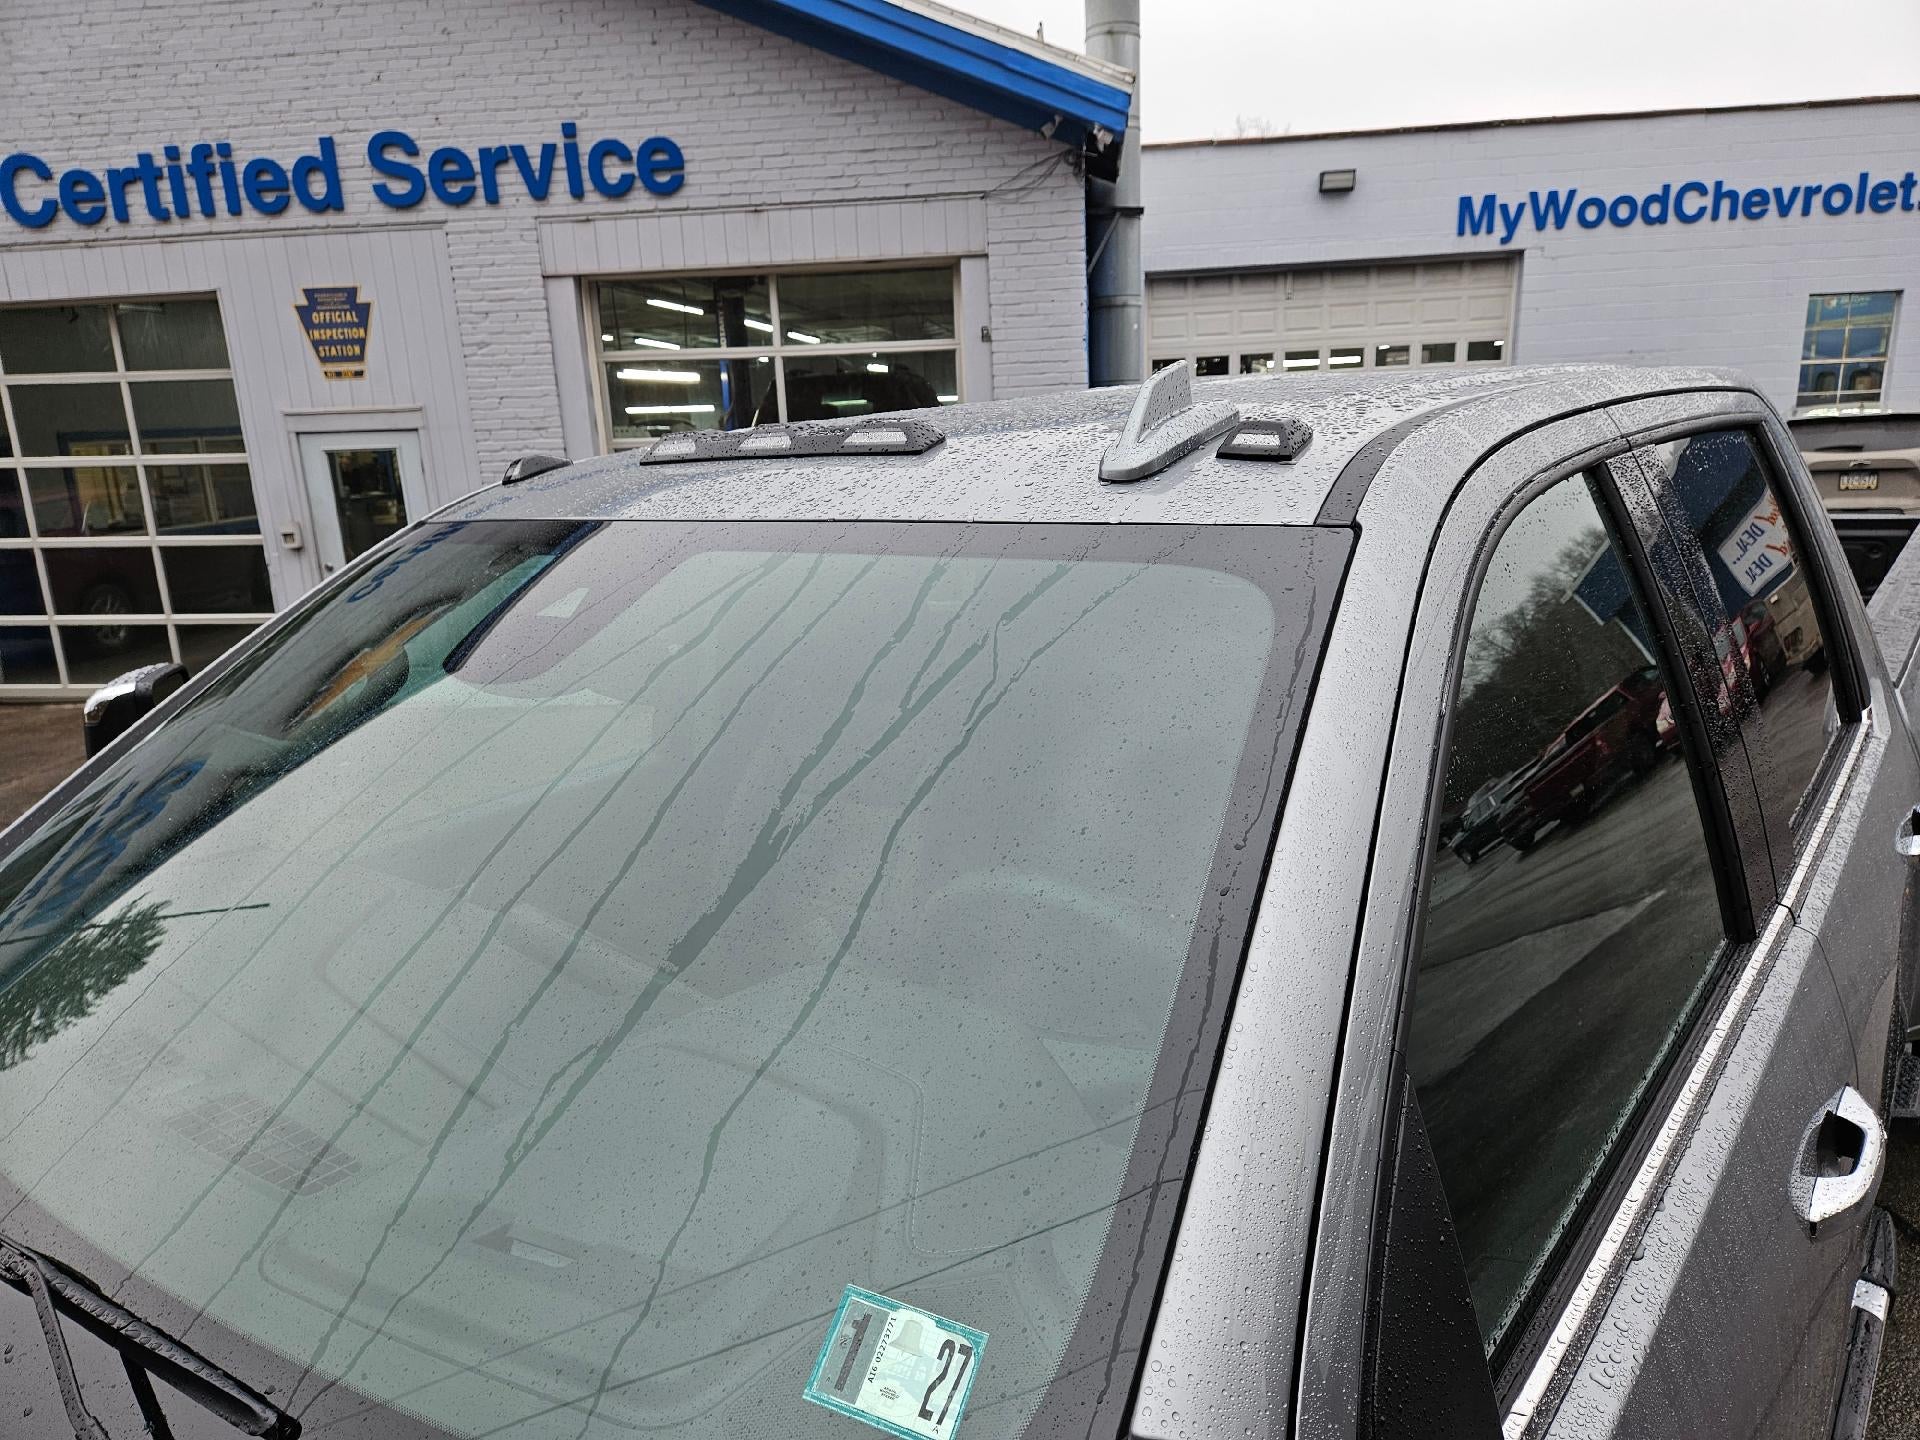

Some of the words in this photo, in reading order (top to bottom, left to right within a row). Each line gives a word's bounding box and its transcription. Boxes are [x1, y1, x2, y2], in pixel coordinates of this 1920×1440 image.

[0, 137, 344, 228] Certified
[367, 121, 685, 209] Service
[312, 311, 359, 324] OFFICIAL
[309, 326, 366, 341] INSPECTION
[318, 344, 361, 357] STATION
[917, 1339, 974, 1426] 27
